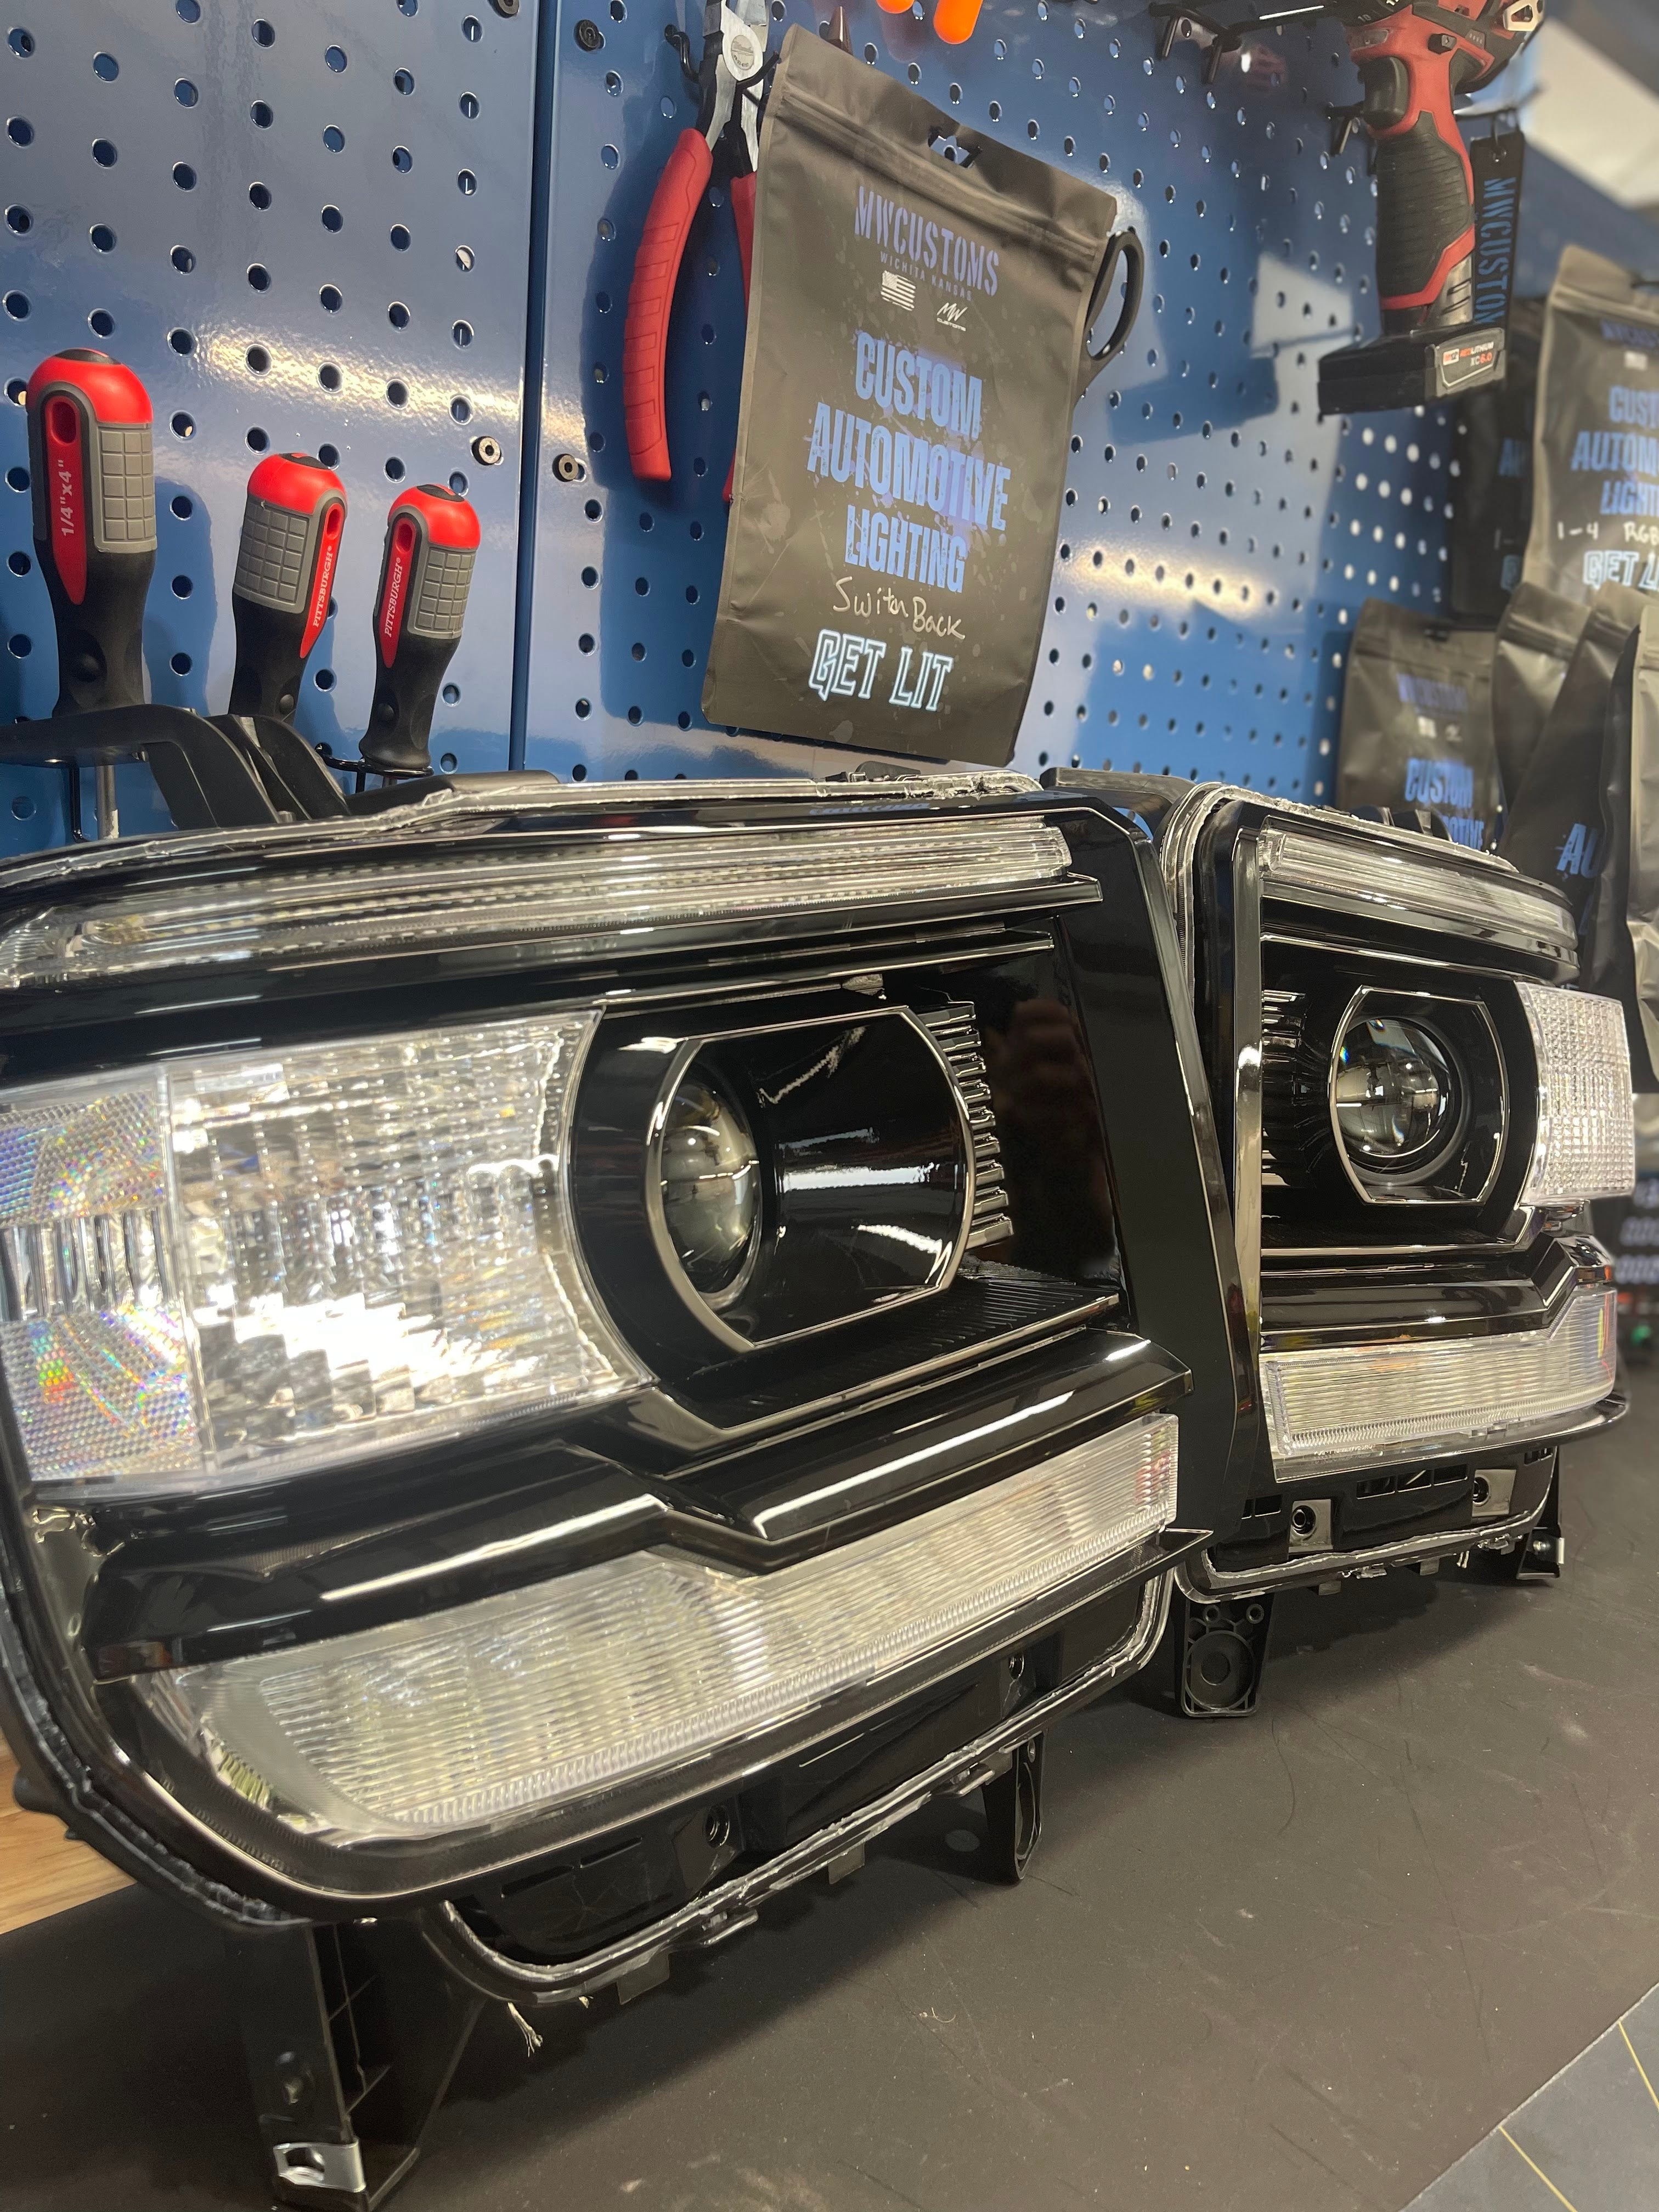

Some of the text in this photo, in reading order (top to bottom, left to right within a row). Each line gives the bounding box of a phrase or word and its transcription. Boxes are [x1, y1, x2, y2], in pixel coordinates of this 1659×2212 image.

[854, 185, 1000, 297] MWCUSTOMS
[881, 251, 972, 301] WICHITA KANSAS
[855, 332, 983, 441] CUSTOM
[807, 402, 1011, 531] AUTOMOTIVE
[844, 505, 968, 593] LIGHTING
[1582, 550, 1640, 590] GET
[912, 596, 966, 640] Back
[808, 629, 954, 712] GET LIT
[1405, 758, 1474, 809] CUSTOM
